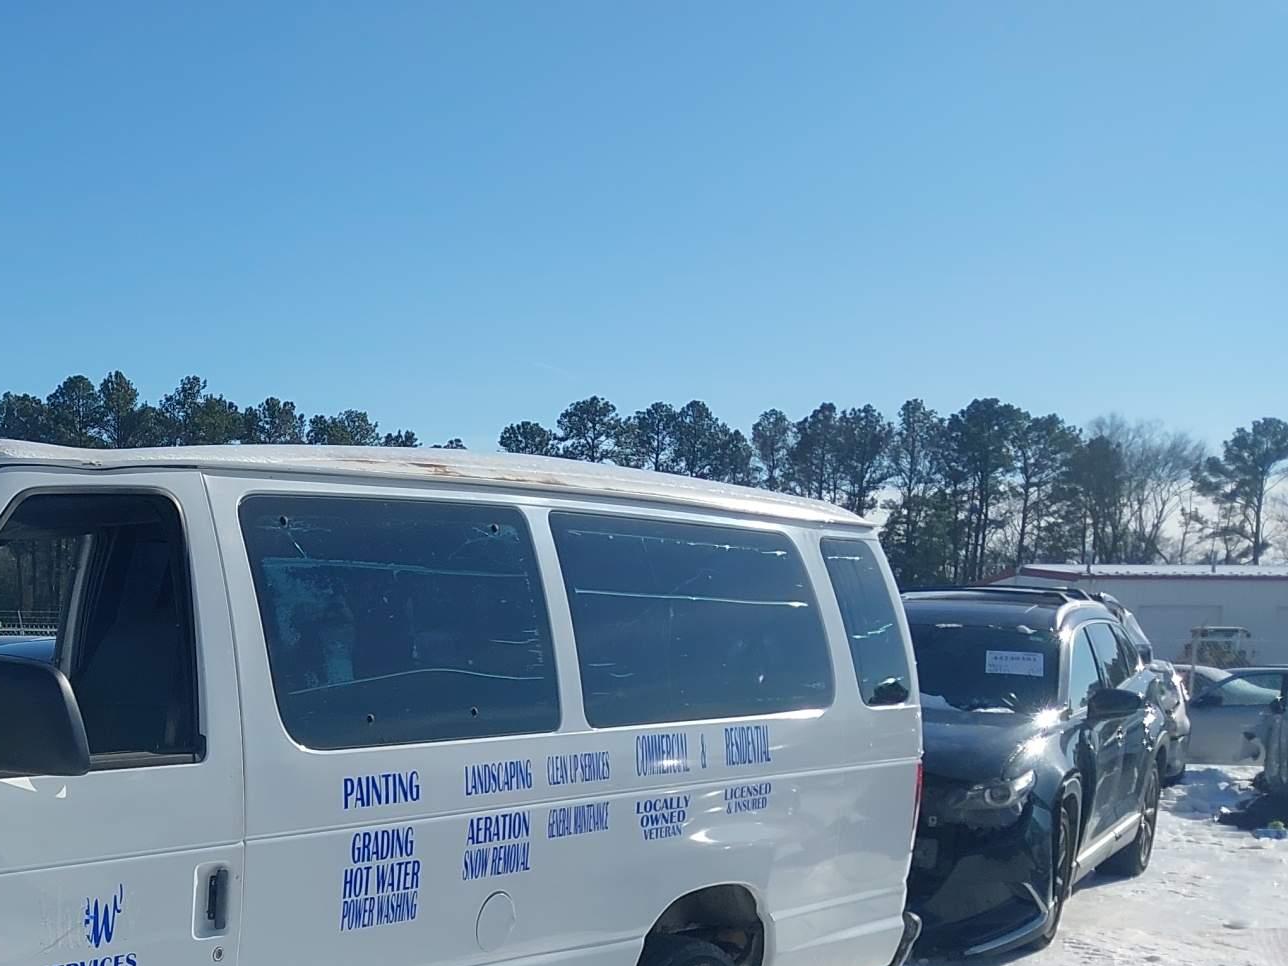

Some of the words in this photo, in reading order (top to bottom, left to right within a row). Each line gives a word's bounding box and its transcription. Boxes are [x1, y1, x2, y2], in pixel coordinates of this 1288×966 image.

[547, 755, 569, 786] CLEAN
[569, 754, 579, 784] UP
[580, 751, 610, 782] SERVICES
[636, 733, 691, 777] COMMERCIAL
[700, 733, 707, 769] &
[724, 726, 772, 767] RESIDENTIAL
[343, 771, 420, 810] PAINTING
[464, 759, 533, 796] LANDSCAPING
[724, 783, 772, 801] LICENSED
[636, 794, 691, 814] LOCALLY
[640, 809, 686, 828] OWNED
[734, 797, 768, 813] INSURED
[466, 811, 530, 846] AERATION
[548, 807, 572, 838] GENERAL
[644, 824, 683, 840] VETERAN
[351, 827, 414, 864] GRADING
[463, 848, 490, 880] SNOW
[490, 842, 530, 876] REMOVAL
[343, 866, 372, 900] HOT
[375, 860, 421, 894] WATER
[340, 898, 374, 932] POWER
[376, 891, 418, 925] WASHING
